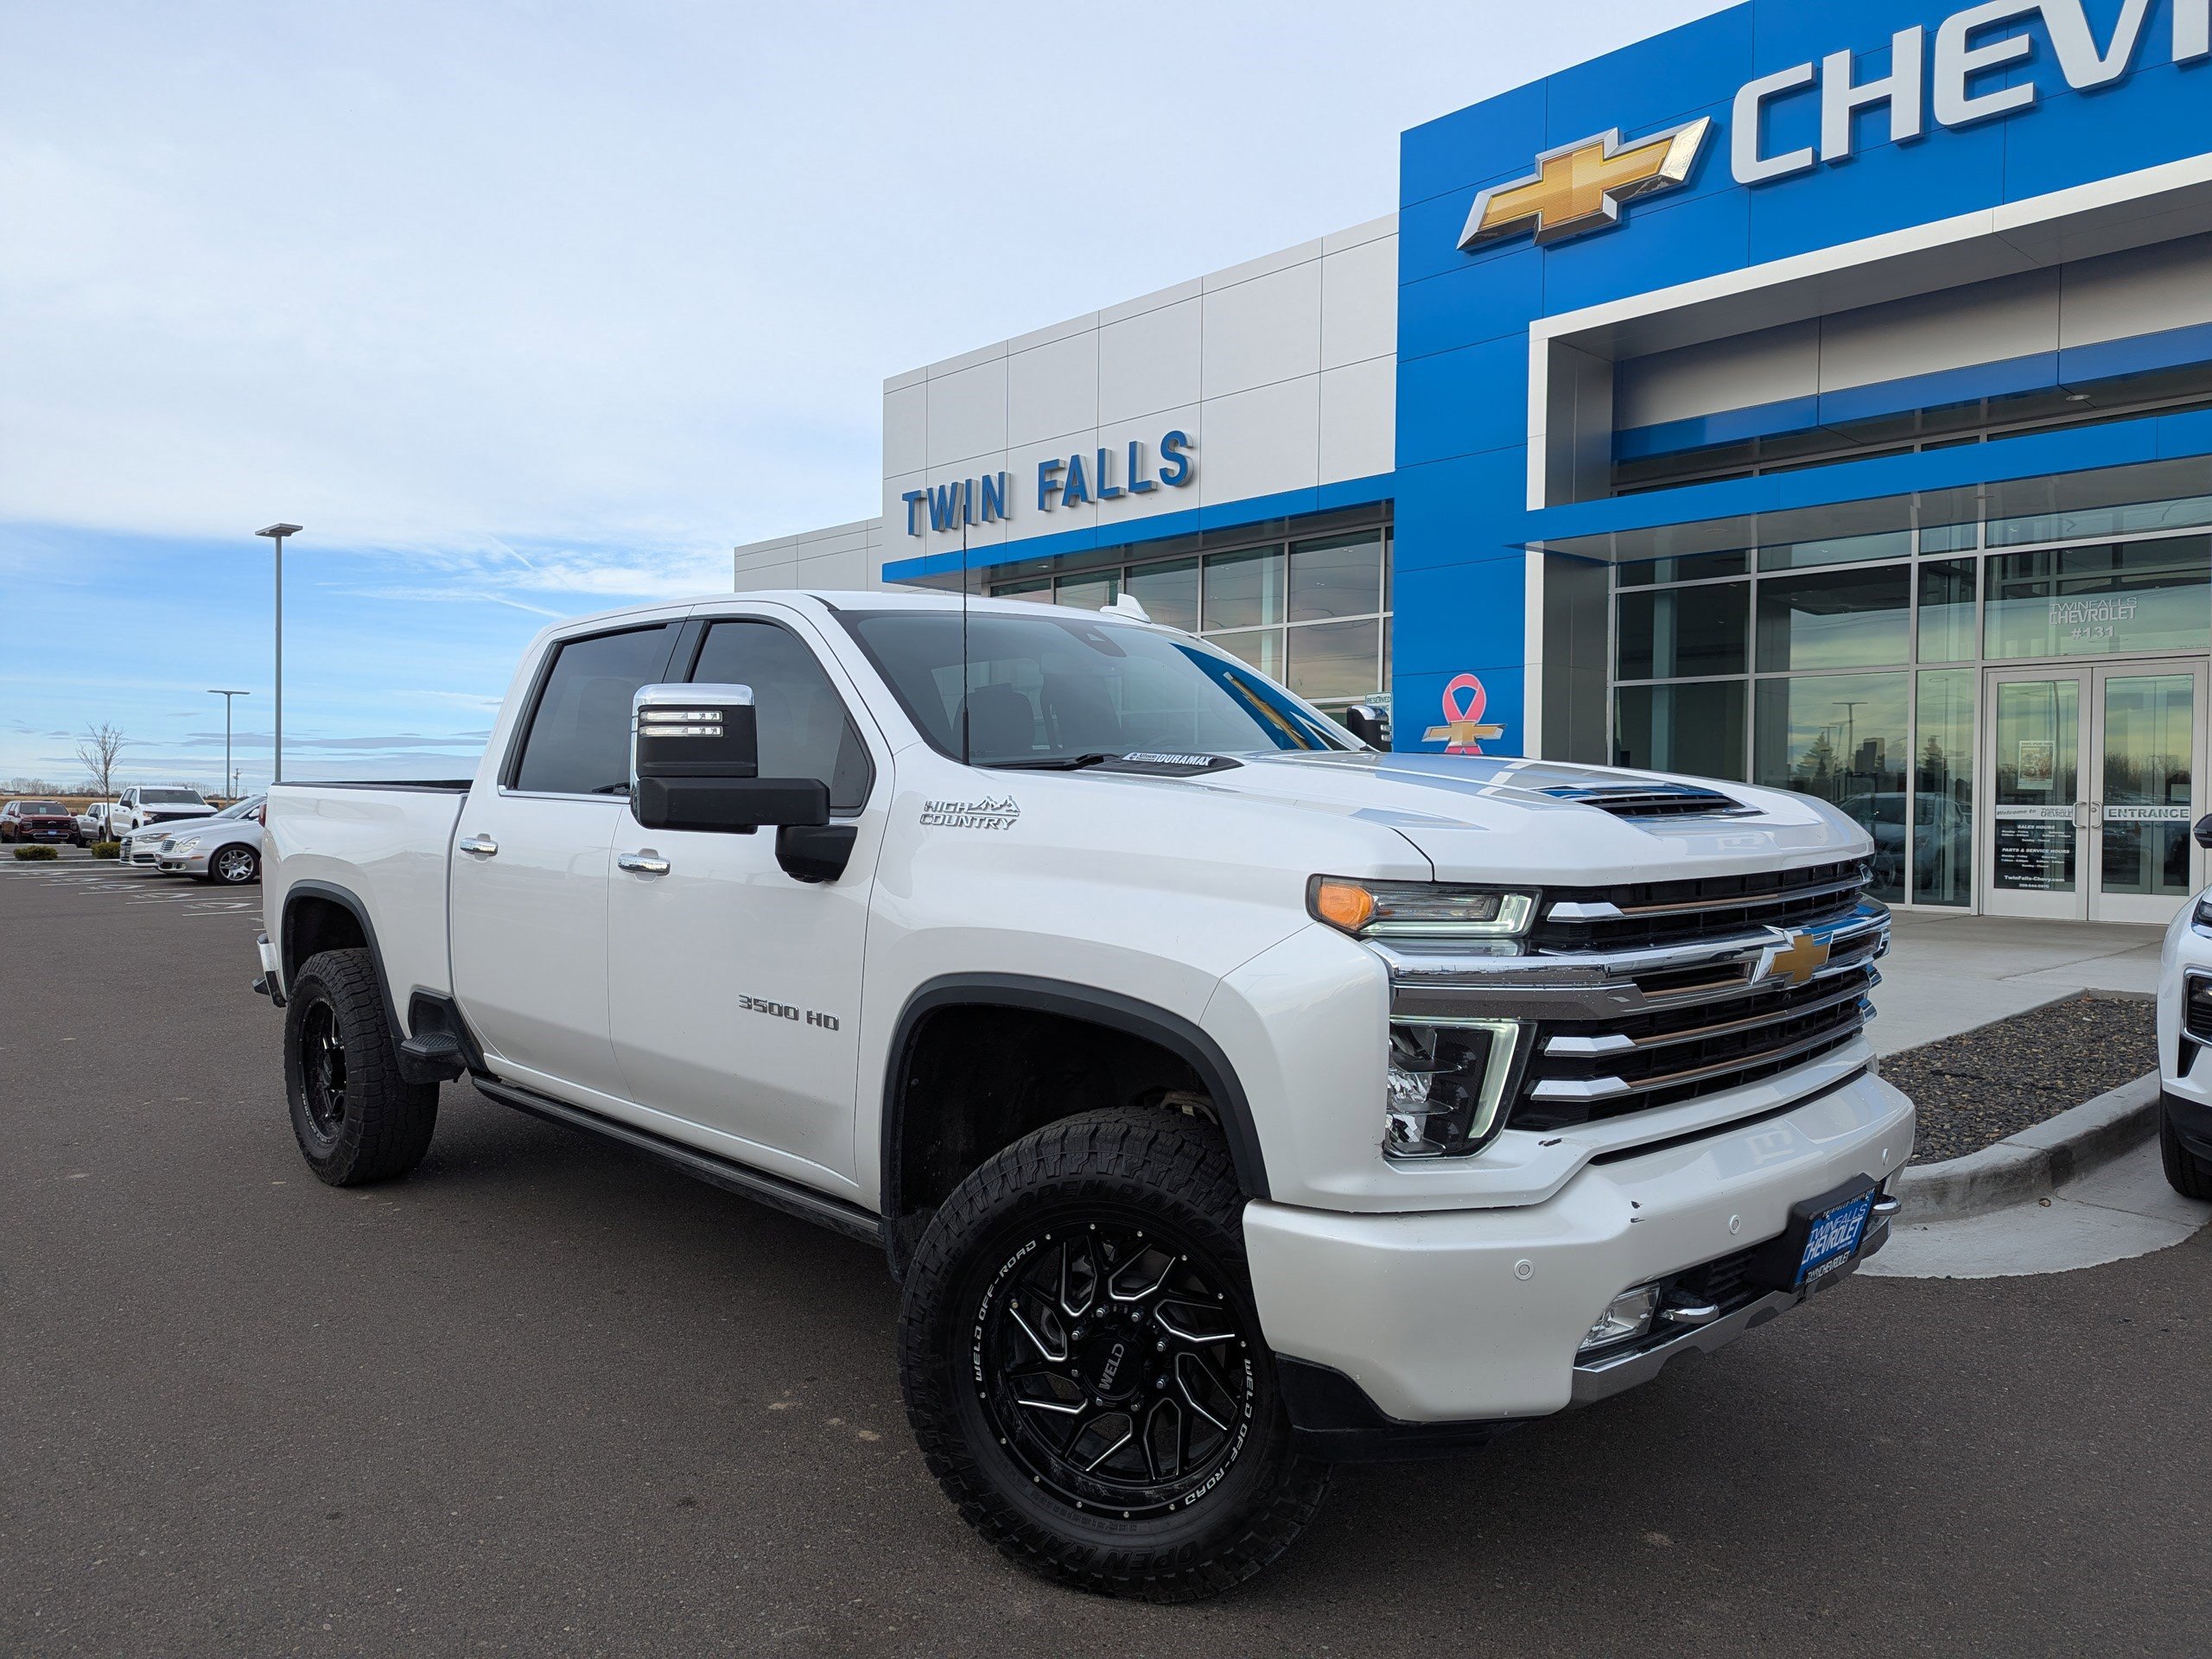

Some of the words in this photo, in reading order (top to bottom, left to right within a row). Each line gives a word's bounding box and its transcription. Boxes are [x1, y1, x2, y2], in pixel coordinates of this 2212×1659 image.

[902, 472, 1011, 537] TWIN
[1038, 430, 1194, 512] FALLS
[2049, 597, 2138, 612] TWINFALLS
[2049, 606, 2138, 626] CHEVROLET
[2071, 626, 2114, 640] #131
[1367, 696, 1391, 704] RESERVED
[1157, 753, 1213, 766] DURAMAX
[924, 800, 973, 813] HIGH
[2108, 808, 2190, 818] ENTRANCE
[919, 813, 1017, 830] COUNTRY
[738, 993, 799, 1021] 3500
[806, 1008, 840, 1031] HD
[1810, 1202, 1868, 1242] TWINFALLS
[1802, 1217, 1864, 1265] CHEVROLET
[973, 1325, 982, 1382] WELD
[978, 1240, 1037, 1320] OFF-ROAD
[1098, 1344, 1124, 1389] WELD
[1244, 1358, 1253, 1419] WELD
[1185, 1423, 1248, 1505] OFF-ROAD
